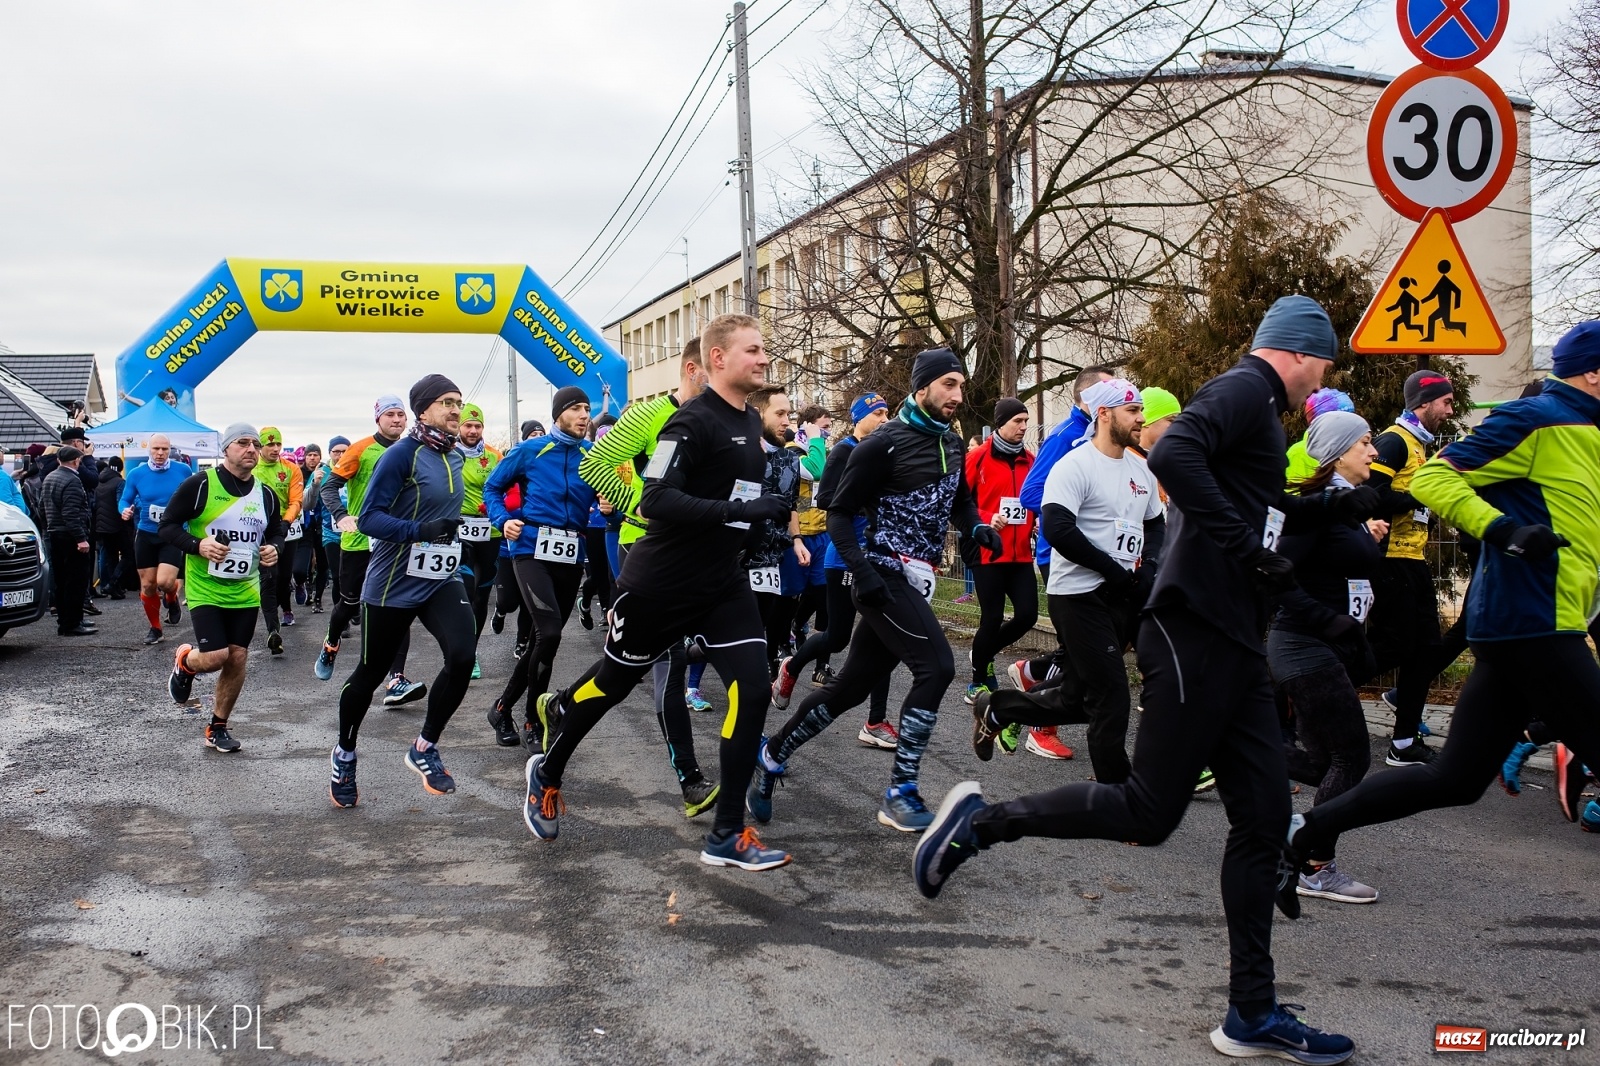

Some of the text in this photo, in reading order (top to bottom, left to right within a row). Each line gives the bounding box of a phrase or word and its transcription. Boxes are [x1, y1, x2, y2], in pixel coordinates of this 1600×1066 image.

[1393, 102, 1494, 182] 30
[340, 269, 419, 283] Gmina
[320, 284, 440, 301] Pietrowice
[335, 302, 425, 317] Wielkie
[146, 282, 229, 359] Gmina ludzi
[525, 290, 603, 364] Gmina ludzi
[164, 301, 243, 373] aktywnych
[513, 308, 586, 376] aktywnych
[1002, 506, 1026, 520] 329
[461, 525, 490, 537] 387
[540, 539, 576, 558] 158
[1116, 533, 1142, 555] 161
[414, 552, 457, 573] 139
[752, 571, 779, 588] 315
